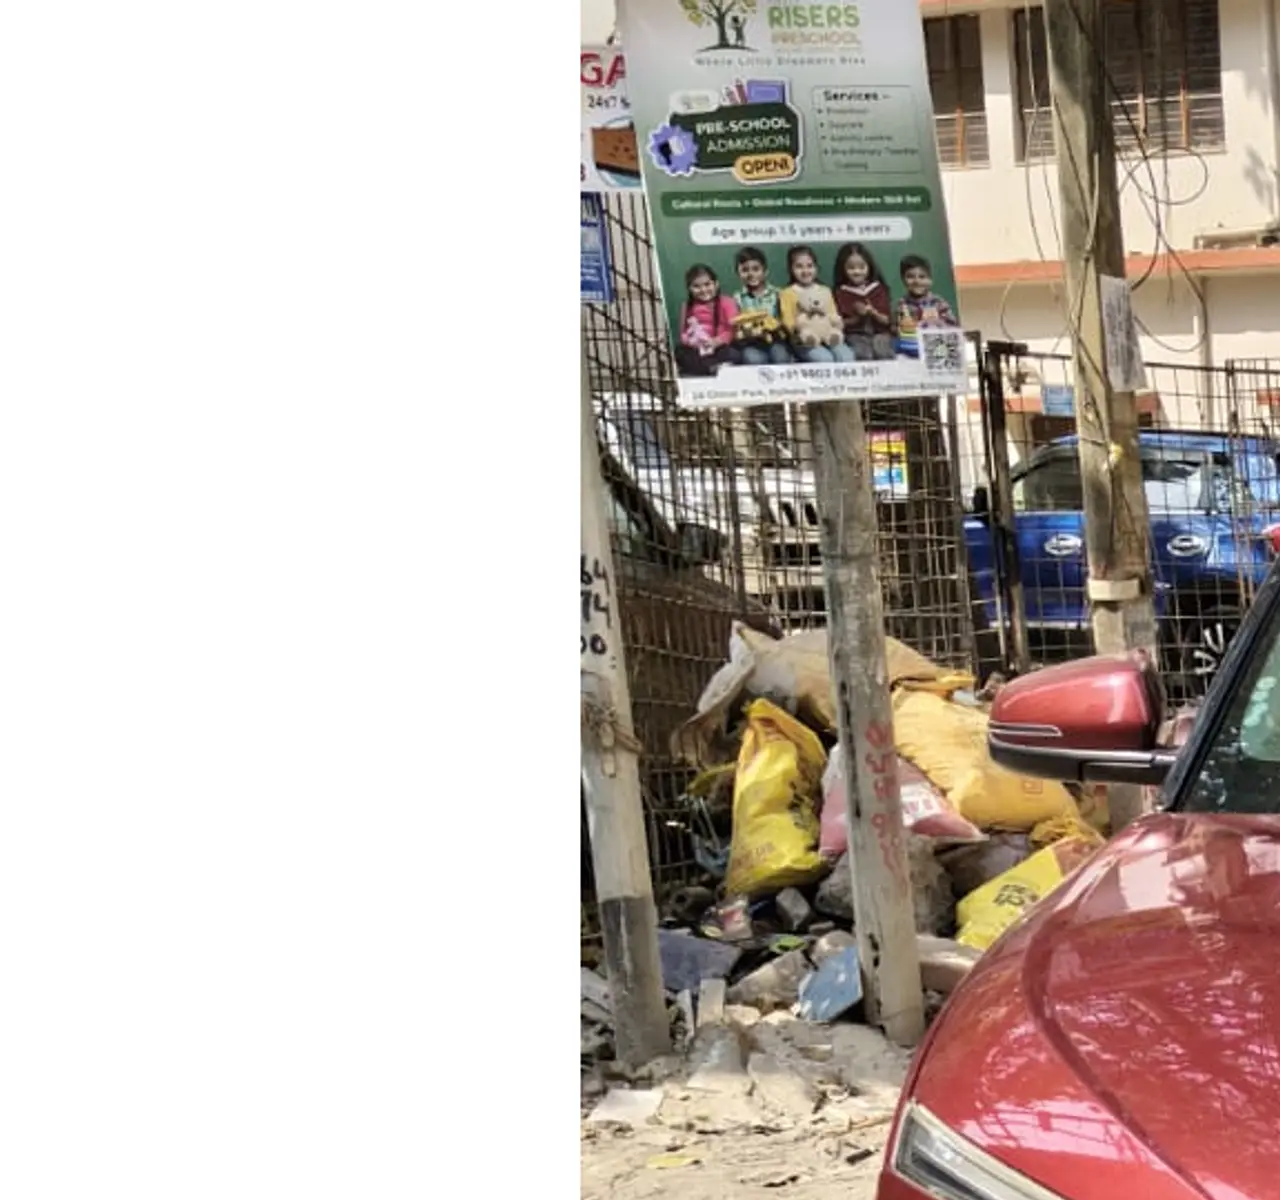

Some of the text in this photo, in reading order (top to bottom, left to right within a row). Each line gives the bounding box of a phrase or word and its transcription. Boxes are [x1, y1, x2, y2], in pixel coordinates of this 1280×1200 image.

[767, 4, 861, 29] RISERS
[771, 31, 862, 45] PRESCHOOL
[823, 89, 879, 101] Services
[695, 116, 792, 136] PRE-SCHOOL
[706, 133, 790, 153] ADMISSION
[710, 226, 736, 239] Age
[740, 226, 777, 239] group
[800, 225, 834, 238] years
[858, 223, 891, 236] years
